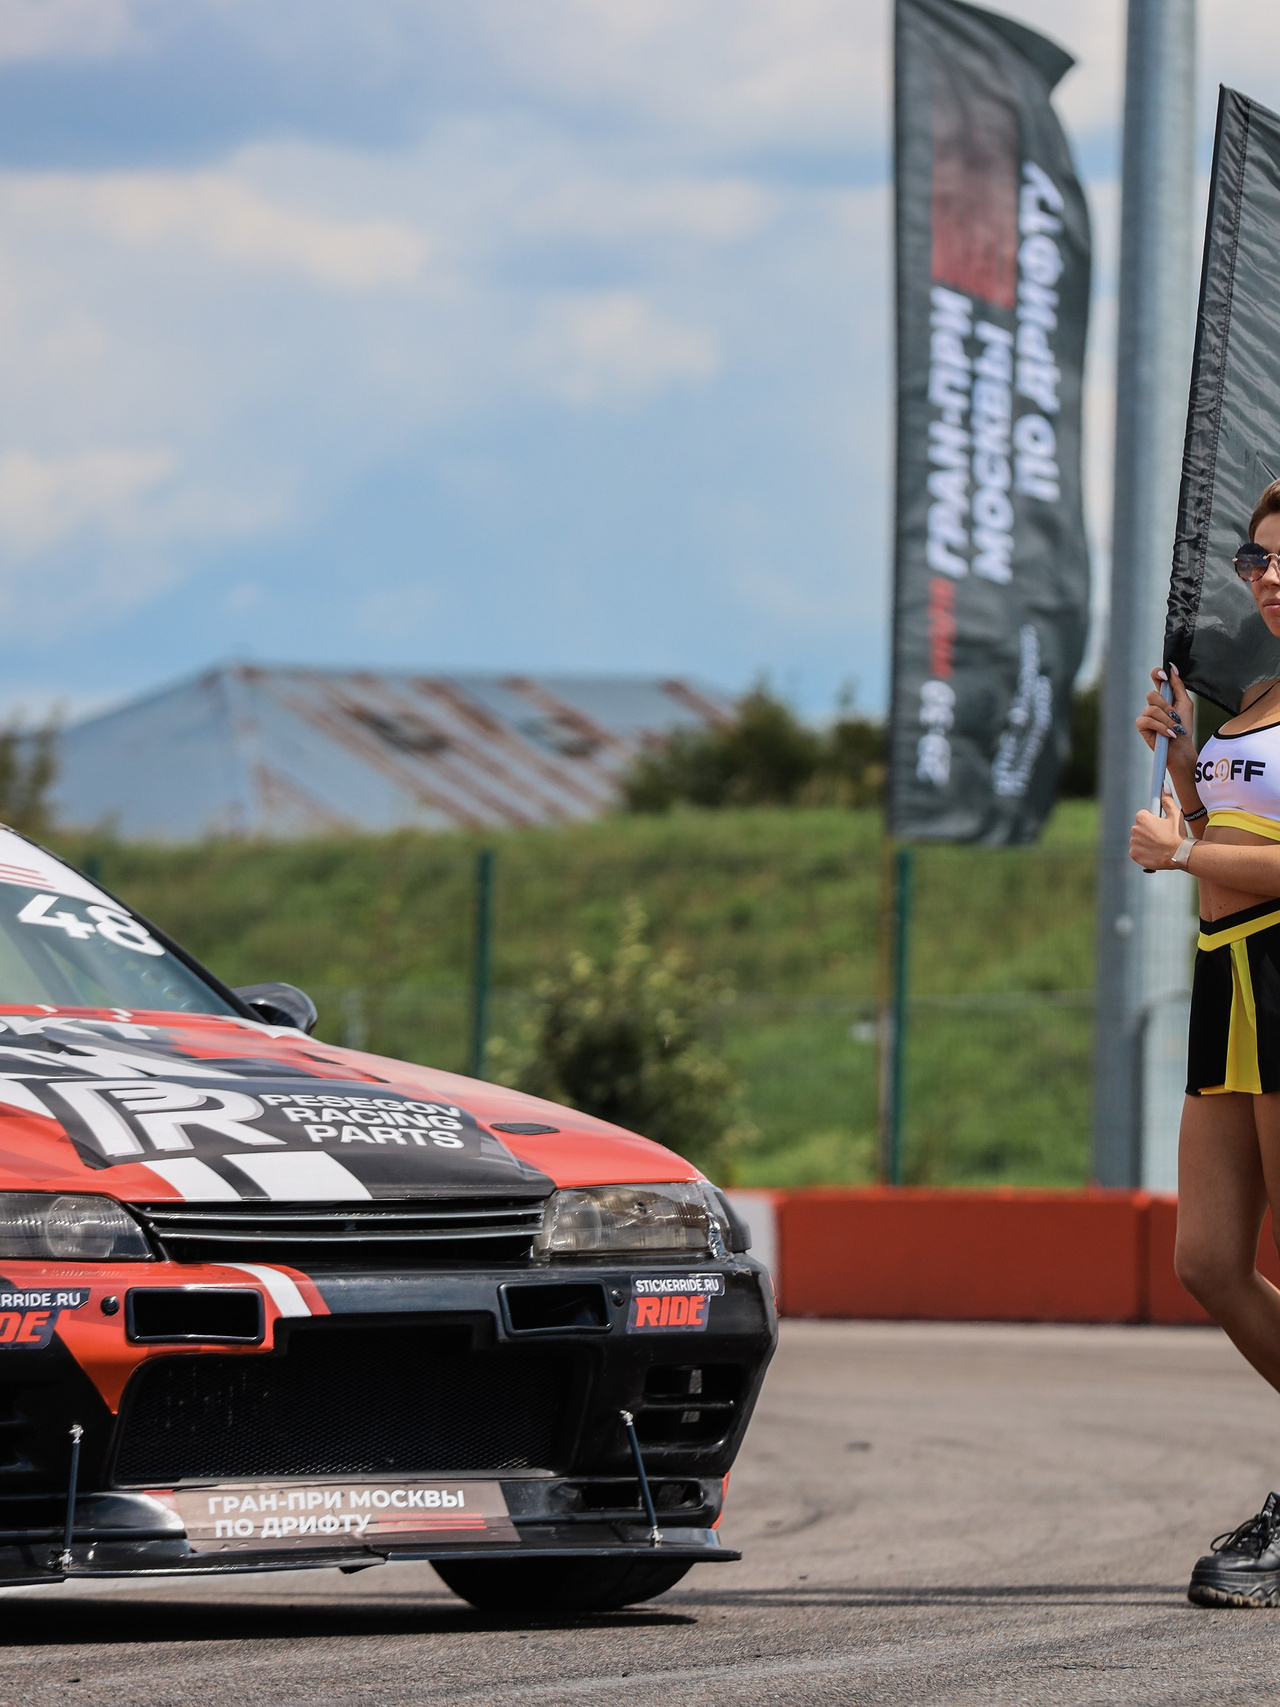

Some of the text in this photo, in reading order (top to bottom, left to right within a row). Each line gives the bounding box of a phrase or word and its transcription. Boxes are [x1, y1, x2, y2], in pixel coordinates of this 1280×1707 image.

[1013, 160, 1064, 502] ПО ДРИФТУ
[926, 285, 973, 579] ГРАН-ПРИ
[972, 321, 1014, 584] МОСКВЫ
[17, 893, 166, 957] 48
[258, 1094, 461, 1119] PESEGOV
[281, 1107, 465, 1131] RACING
[303, 1124, 466, 1150] PARTS
[635, 1278, 720, 1293] STICKERRIDE.RU
[0, 1292, 81, 1308] RRIDE.RU
[635, 1295, 706, 1327] RIDE
[207, 1489, 466, 1515] ГРАН-ПРИ МОСКВЫ
[215, 1513, 373, 1540] ПО ДРИФТУ
